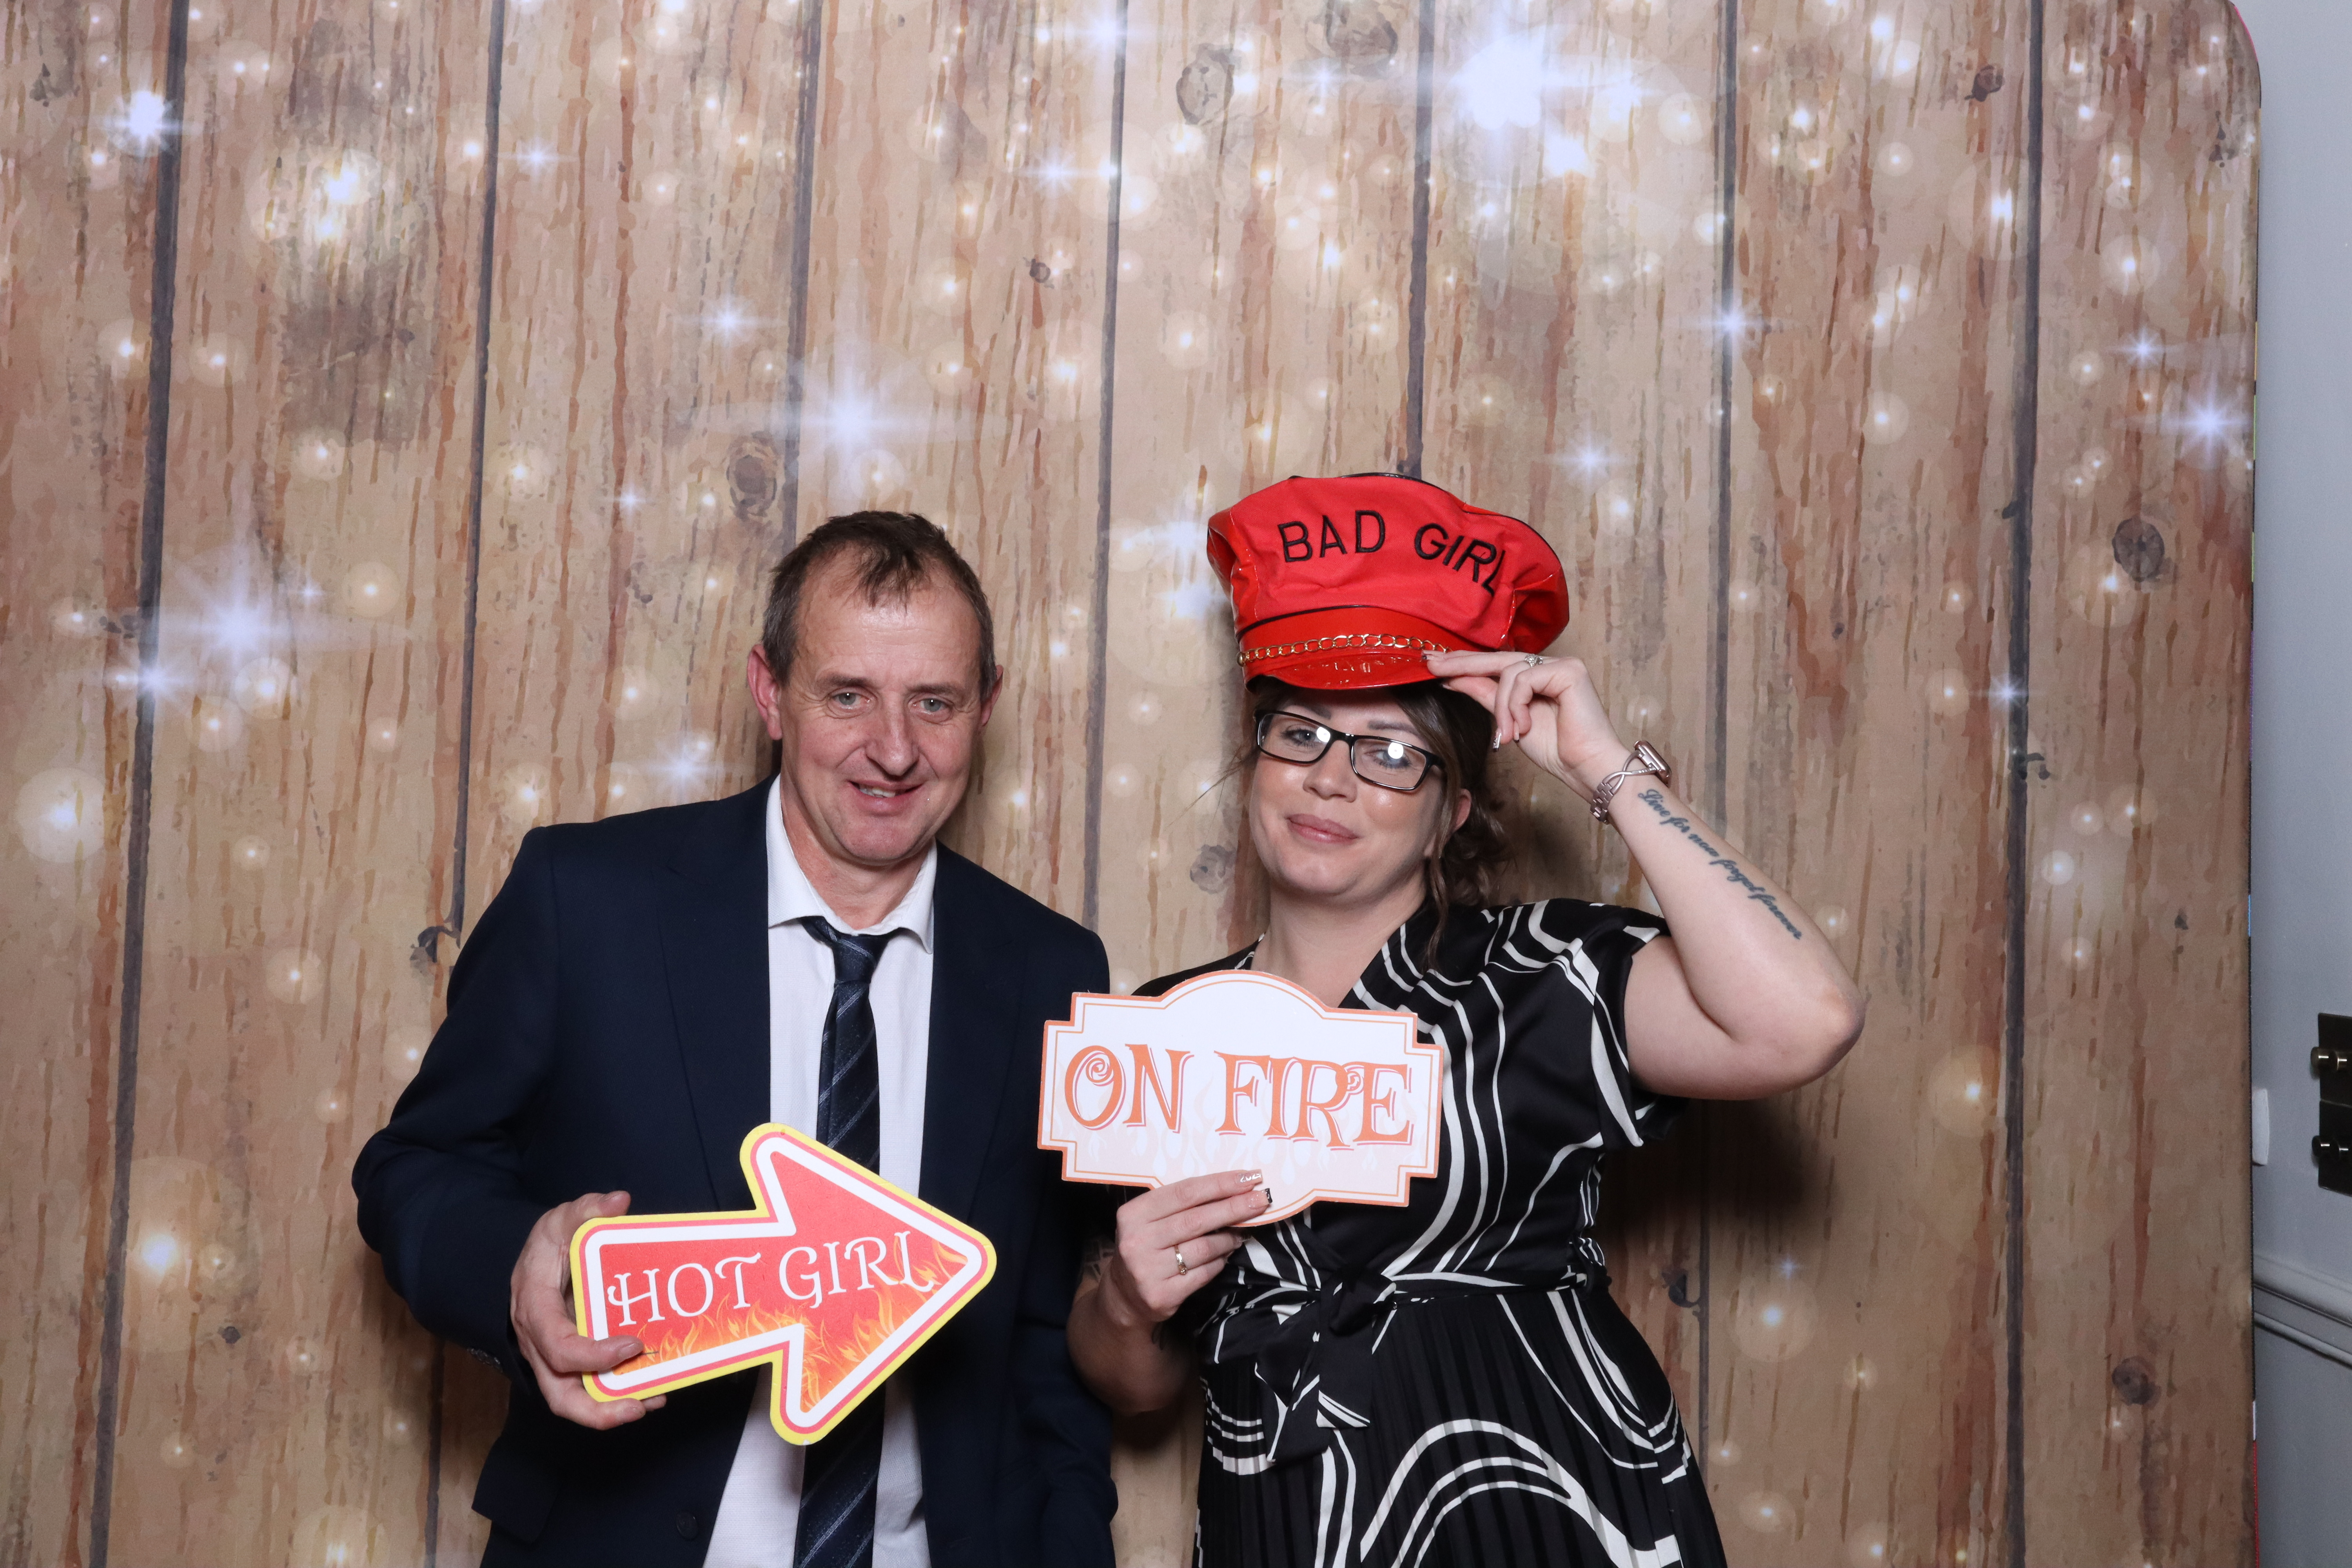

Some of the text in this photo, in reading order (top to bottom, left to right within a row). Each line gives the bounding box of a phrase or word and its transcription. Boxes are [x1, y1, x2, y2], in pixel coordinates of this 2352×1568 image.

[1278, 510, 1505, 596] BAD GIRL
[1637, 788, 1671, 817] Live
[1659, 816, 1690, 833] for
[1709, 859, 1766, 893] forget
[1748, 893, 1802, 940] forever
[1064, 1043, 1414, 1151] ON FIRE
[608, 1230, 934, 1327] HOT GIRL
